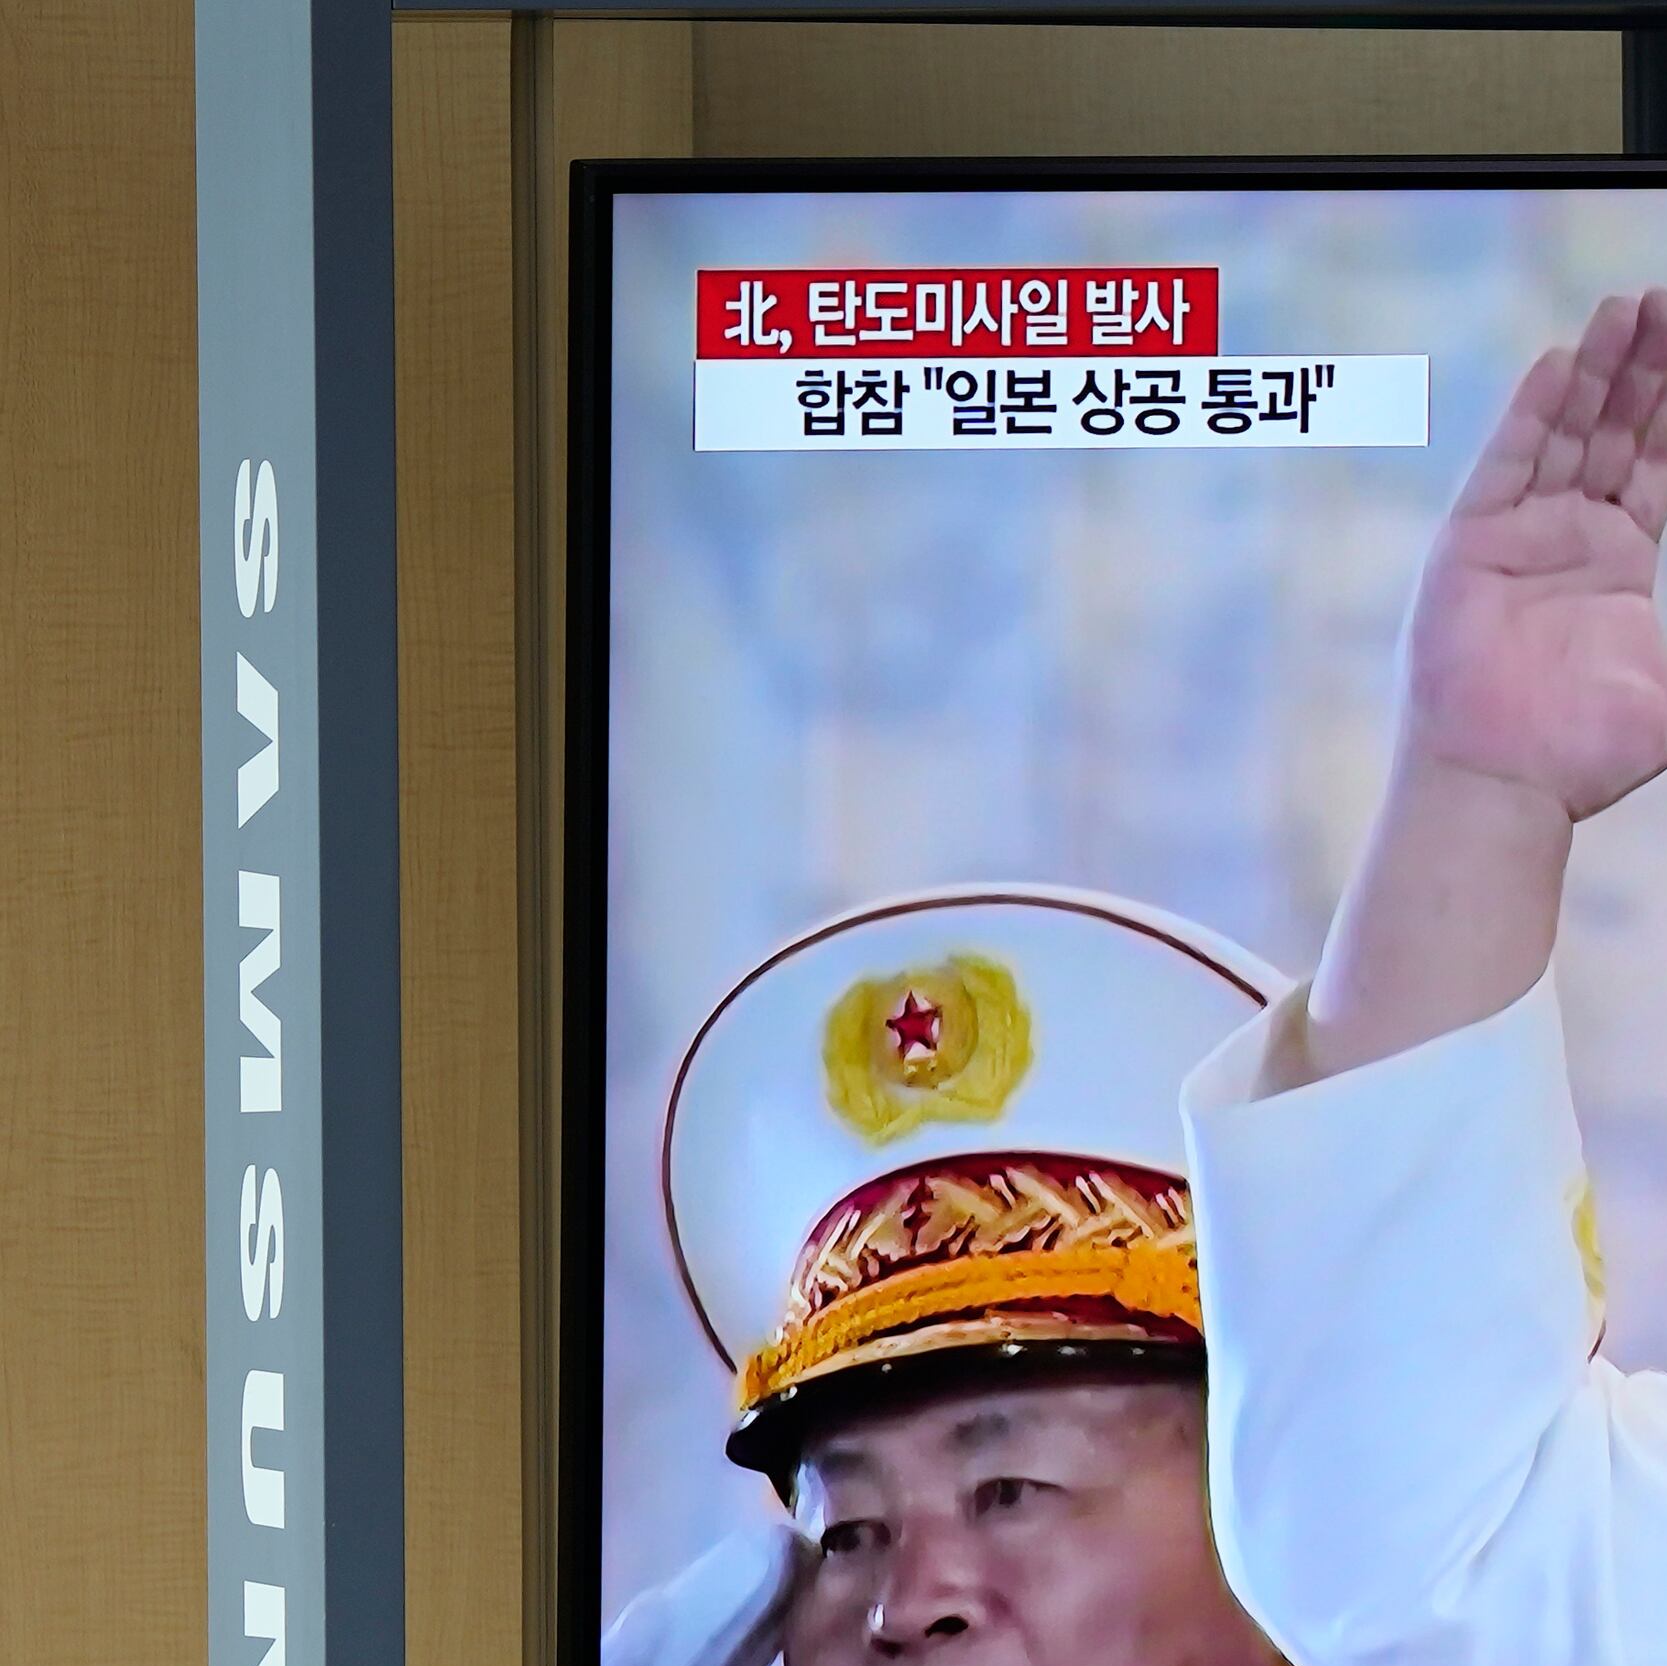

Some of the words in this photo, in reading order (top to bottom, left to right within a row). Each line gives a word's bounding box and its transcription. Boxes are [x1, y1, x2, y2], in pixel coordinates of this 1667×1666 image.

[723, 280, 793, 354] 北,
[807, 278, 1070, 347] 탄도미사일
[1084, 277, 1190, 345] 발사
[796, 368, 910, 437] 합참
[923, 366, 1057, 436] "일본
[1072, 368, 1187, 436] 상공
[1200, 363, 1335, 435] 통과"
